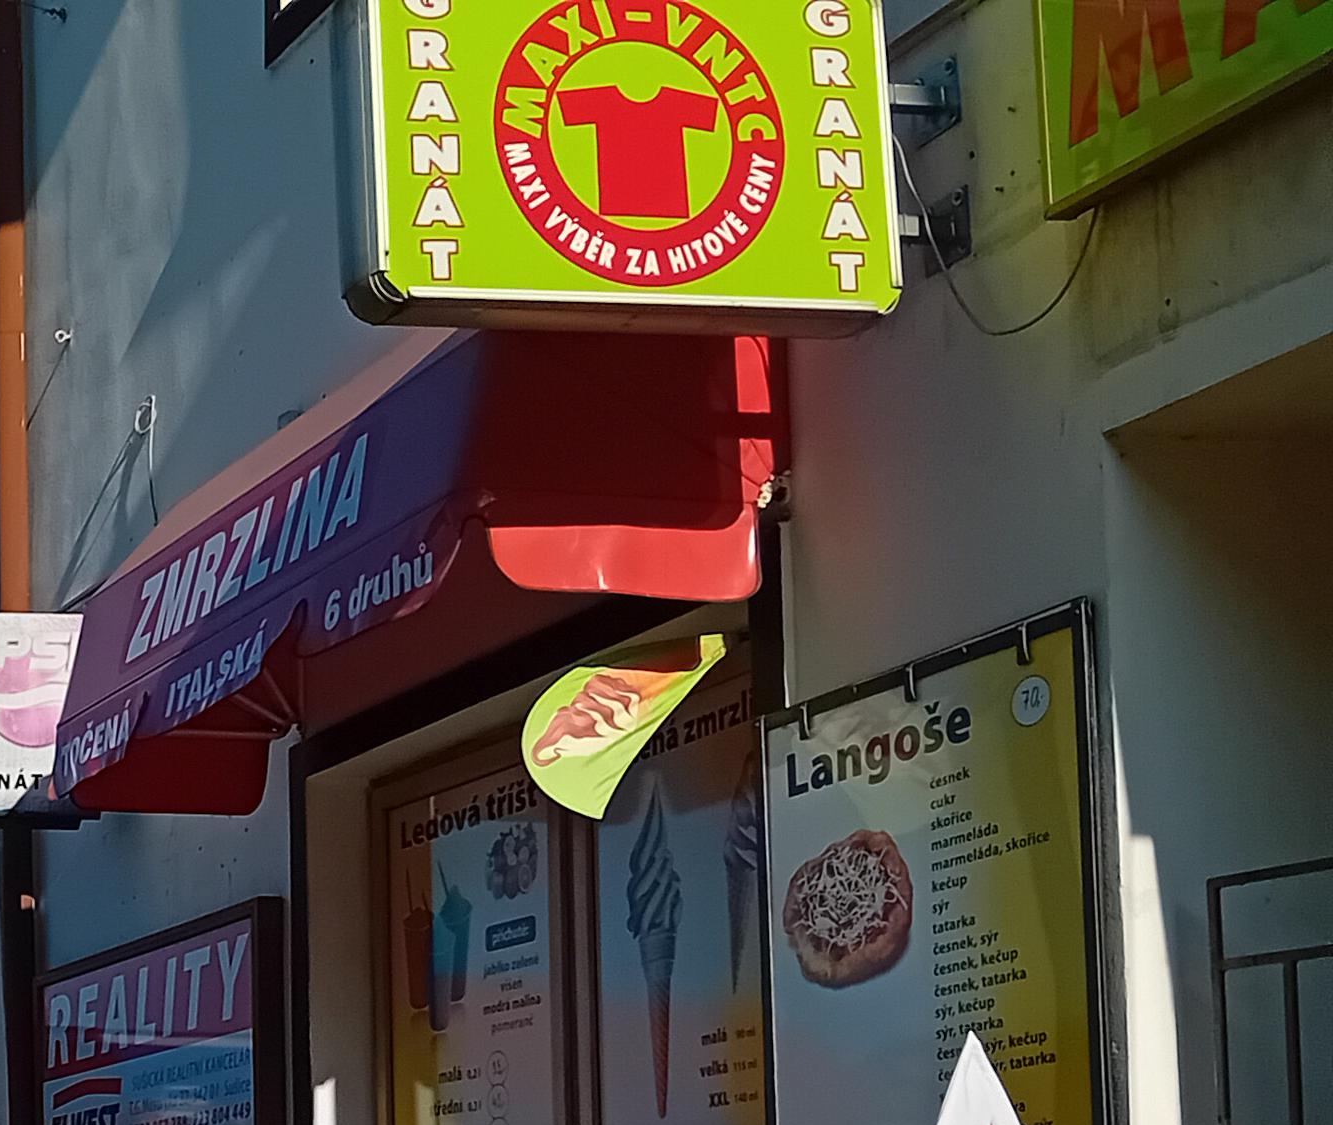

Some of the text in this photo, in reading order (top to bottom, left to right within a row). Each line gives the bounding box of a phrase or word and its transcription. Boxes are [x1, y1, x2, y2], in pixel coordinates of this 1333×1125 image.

[803, 0, 869, 293] GRANÁT
[504, 142, 776, 276] MAXI VÝBĚR ZA HITOVÉ CENY
[125, 432, 369, 664] ZMRZLINA
[165, 618, 268, 719] ITALSKÁ
[323, 589, 341, 631] 6
[347, 542, 433, 620] druhů
[786, 701, 973, 798] Langoše
[930, 766, 971, 789] česnek
[930, 794, 956, 810] cukr
[401, 795, 481, 849] Ledová
[931, 811, 973, 831] skořice
[931, 823, 999, 851] marmeláda
[932, 831, 1050, 872] marmeláda, skořice
[932, 876, 968, 893] kečup
[932, 899, 950, 915] sýr
[933, 915, 976, 935] tatarka
[933, 930, 999, 955] česnek, sýr
[933, 949, 1019, 976] česnek, kečup
[934, 967, 1027, 998] česnek, tatarka
[47, 932, 250, 1069] REALITY
[935, 997, 995, 1021] sýr, kečup
[936, 1016, 1004, 1041] sýr, tatarka
[1008, 1032, 1047, 1049] kečup
[1009, 1052, 1057, 1070] tatarka
